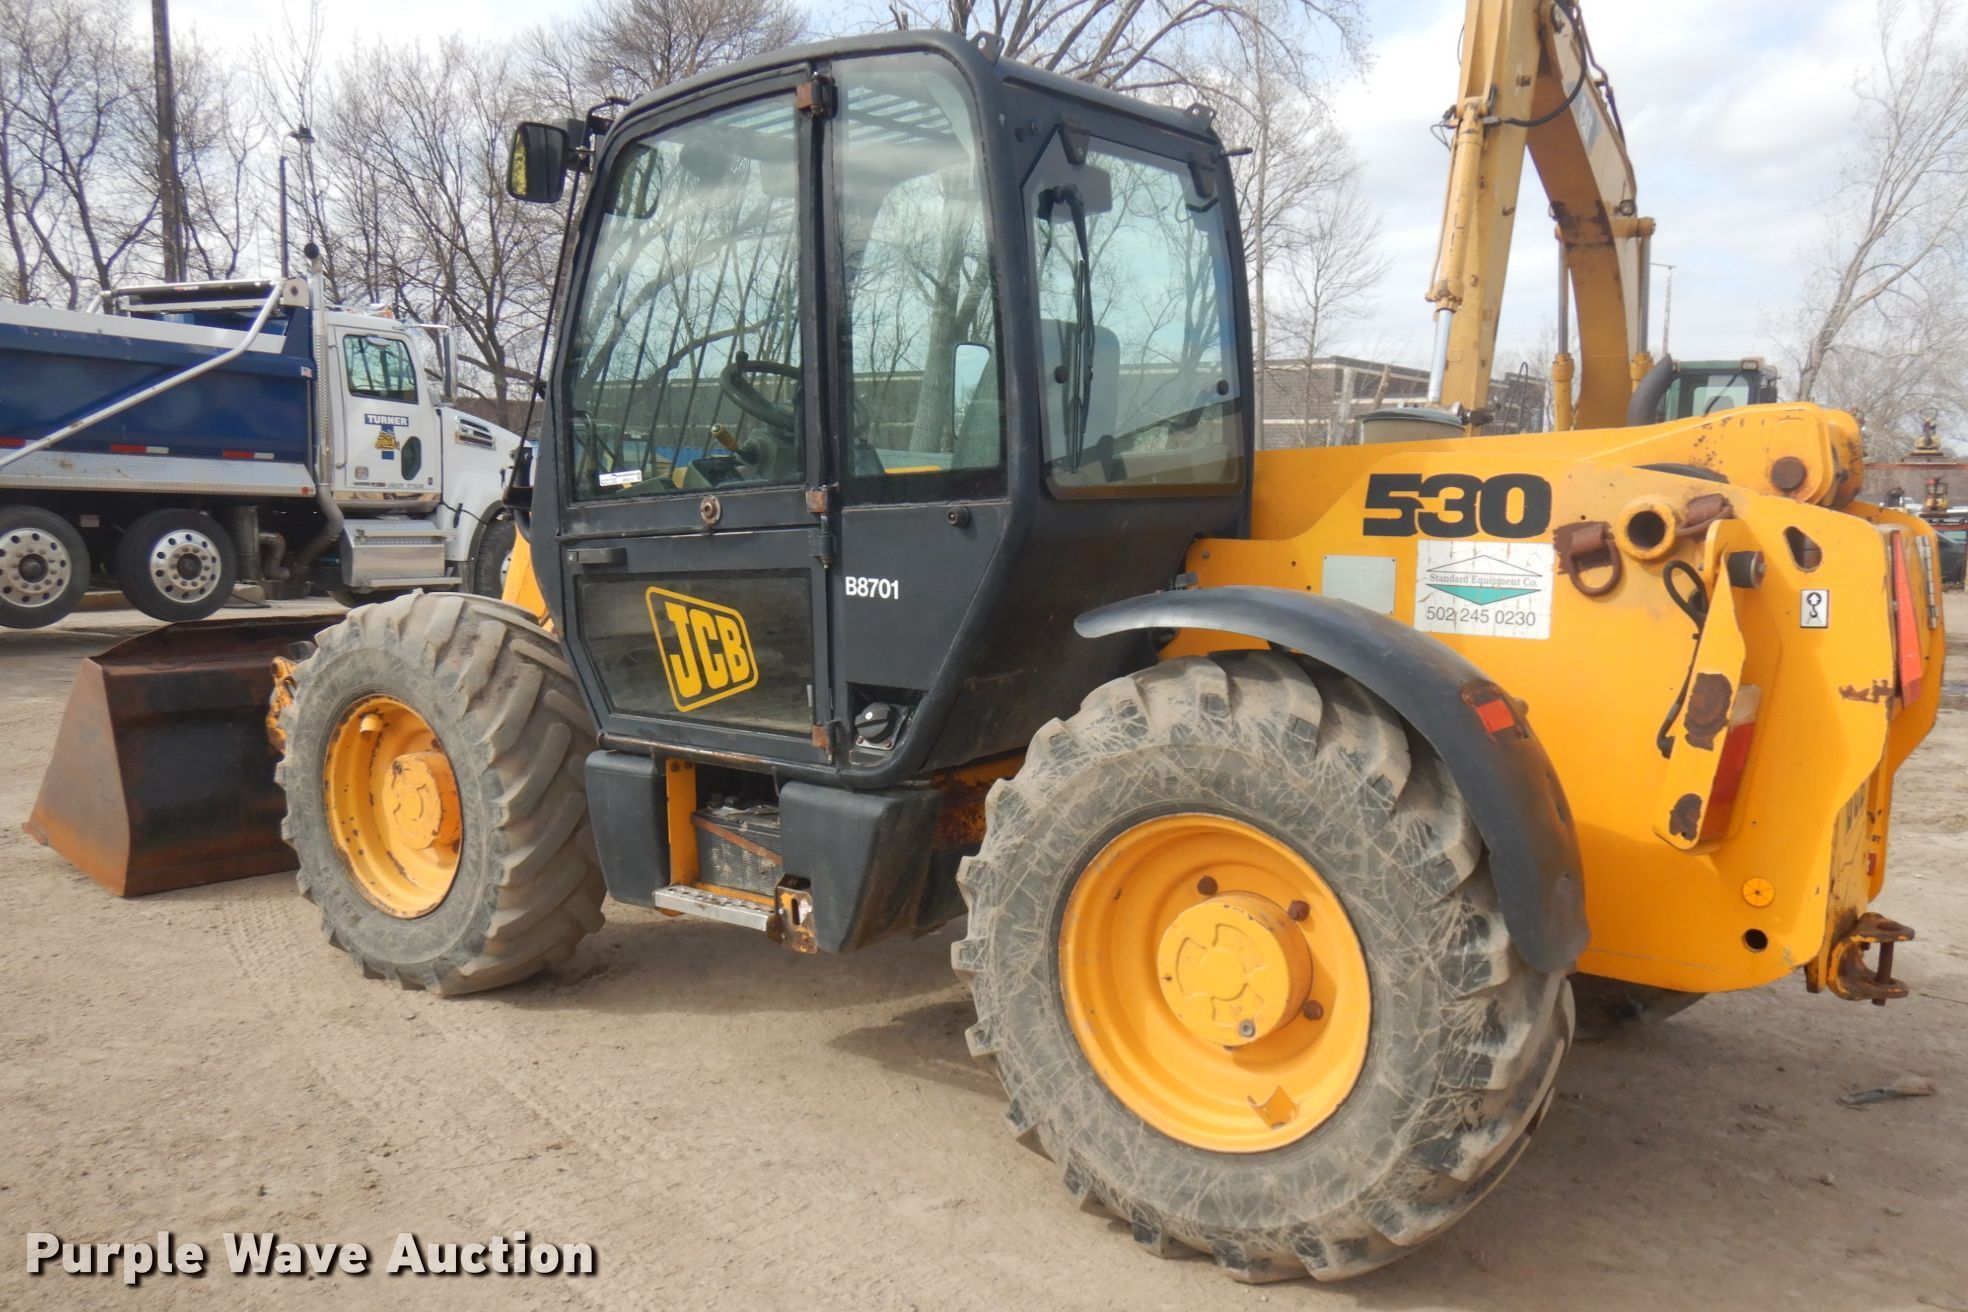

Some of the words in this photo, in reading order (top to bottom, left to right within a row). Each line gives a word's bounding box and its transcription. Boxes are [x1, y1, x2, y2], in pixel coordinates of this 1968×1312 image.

[367, 414, 408, 426] TURNER
[1363, 473, 1552, 538] 530
[845, 576, 899, 600] B8701
[1430, 573, 1469, 584] Standard
[1471, 575, 1521, 588] Equipment
[1523, 577, 1538, 587] Co.
[1426, 606, 1455, 621] 502
[1460, 608, 1489, 624] 245
[1495, 610, 1536, 626] 0230
[664, 601, 750, 698] JCB
